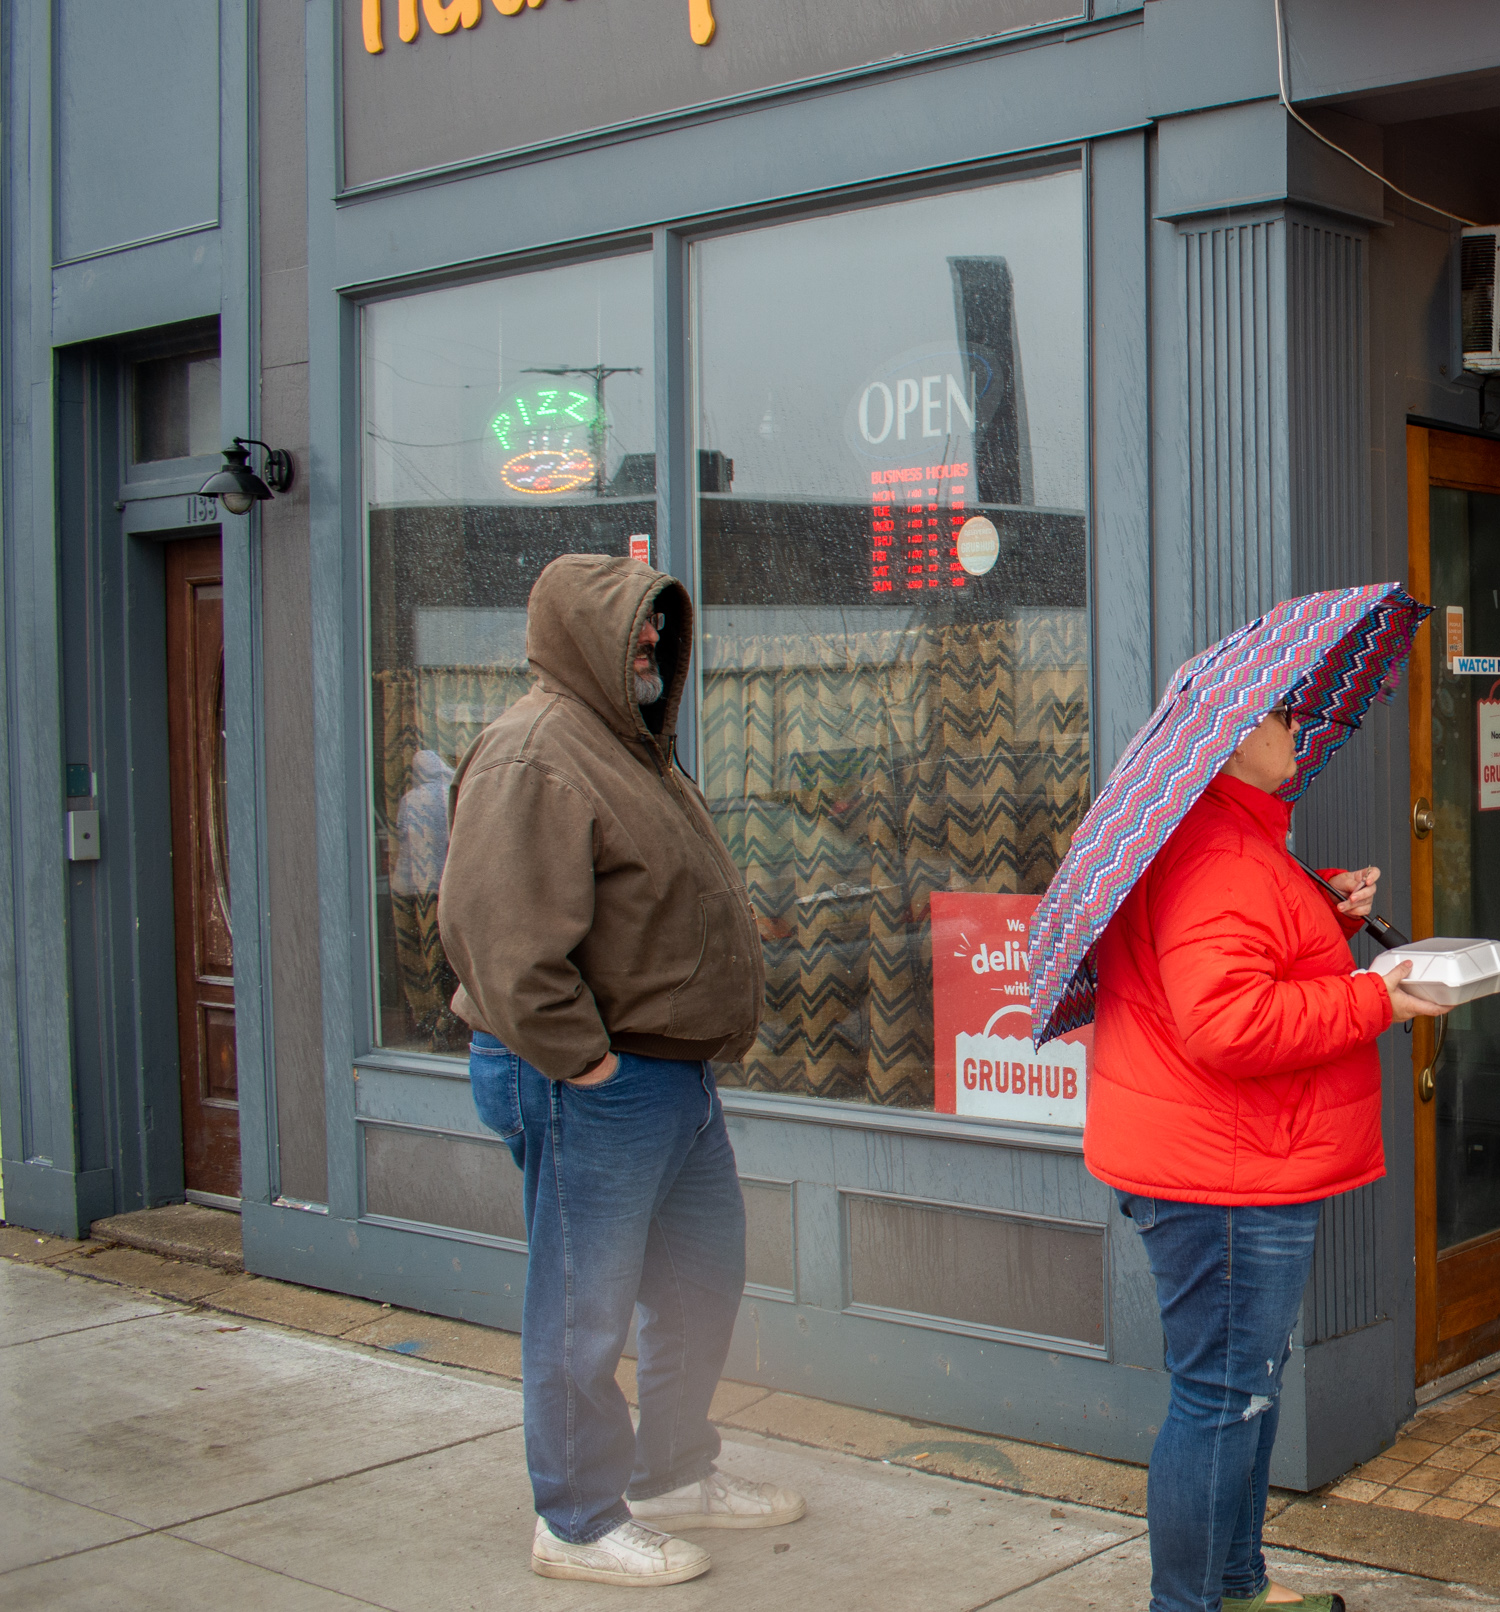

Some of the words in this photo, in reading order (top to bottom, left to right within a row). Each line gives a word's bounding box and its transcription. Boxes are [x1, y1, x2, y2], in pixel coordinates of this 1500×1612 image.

[858, 371, 977, 444] OPEN
[871, 467, 922, 485] BUSINESS
[926, 463, 968, 480] HOURS
[872, 490, 896, 502] MON
[872, 505, 891, 517] TUE
[872, 535, 893, 547] THU
[960, 540, 996, 553] GRUBHUB
[872, 565, 890, 577] SAT
[872, 580, 893, 592] SUN
[1458, 658, 1495, 672] WATCH
[1007, 919, 1026, 932] We
[1004, 981, 1030, 996] with
[963, 1057, 1078, 1100] GRUBHUB
